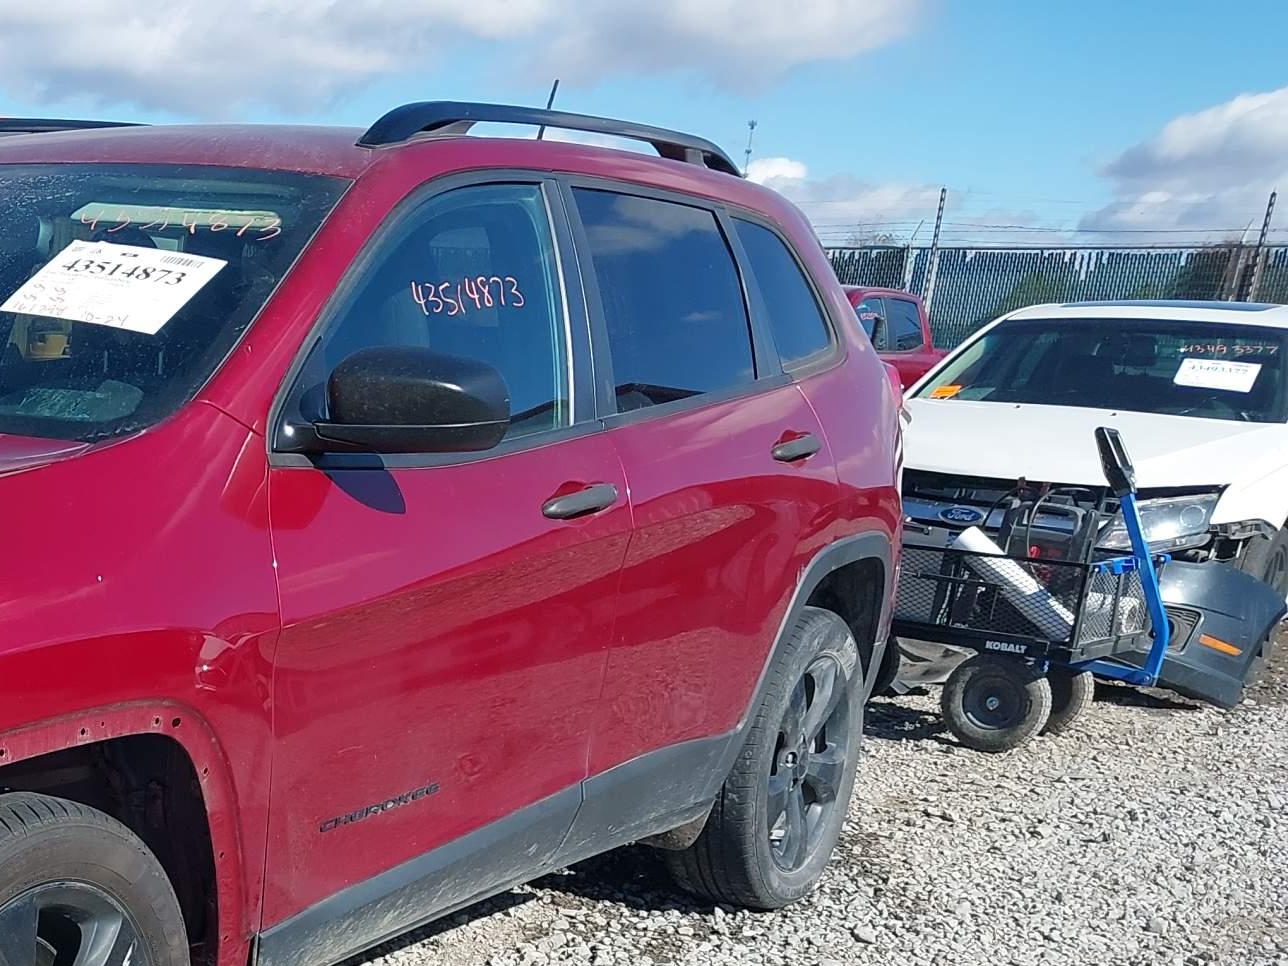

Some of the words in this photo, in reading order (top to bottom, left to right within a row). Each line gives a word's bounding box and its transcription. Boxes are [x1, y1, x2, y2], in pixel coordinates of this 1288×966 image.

[61, 258, 187, 286] 43514873
[411, 276, 525, 315] 43514873
[946, 508, 976, 521] Ford
[984, 640, 1028, 654] KOBALT
[319, 782, 441, 833] CHEROKEE
